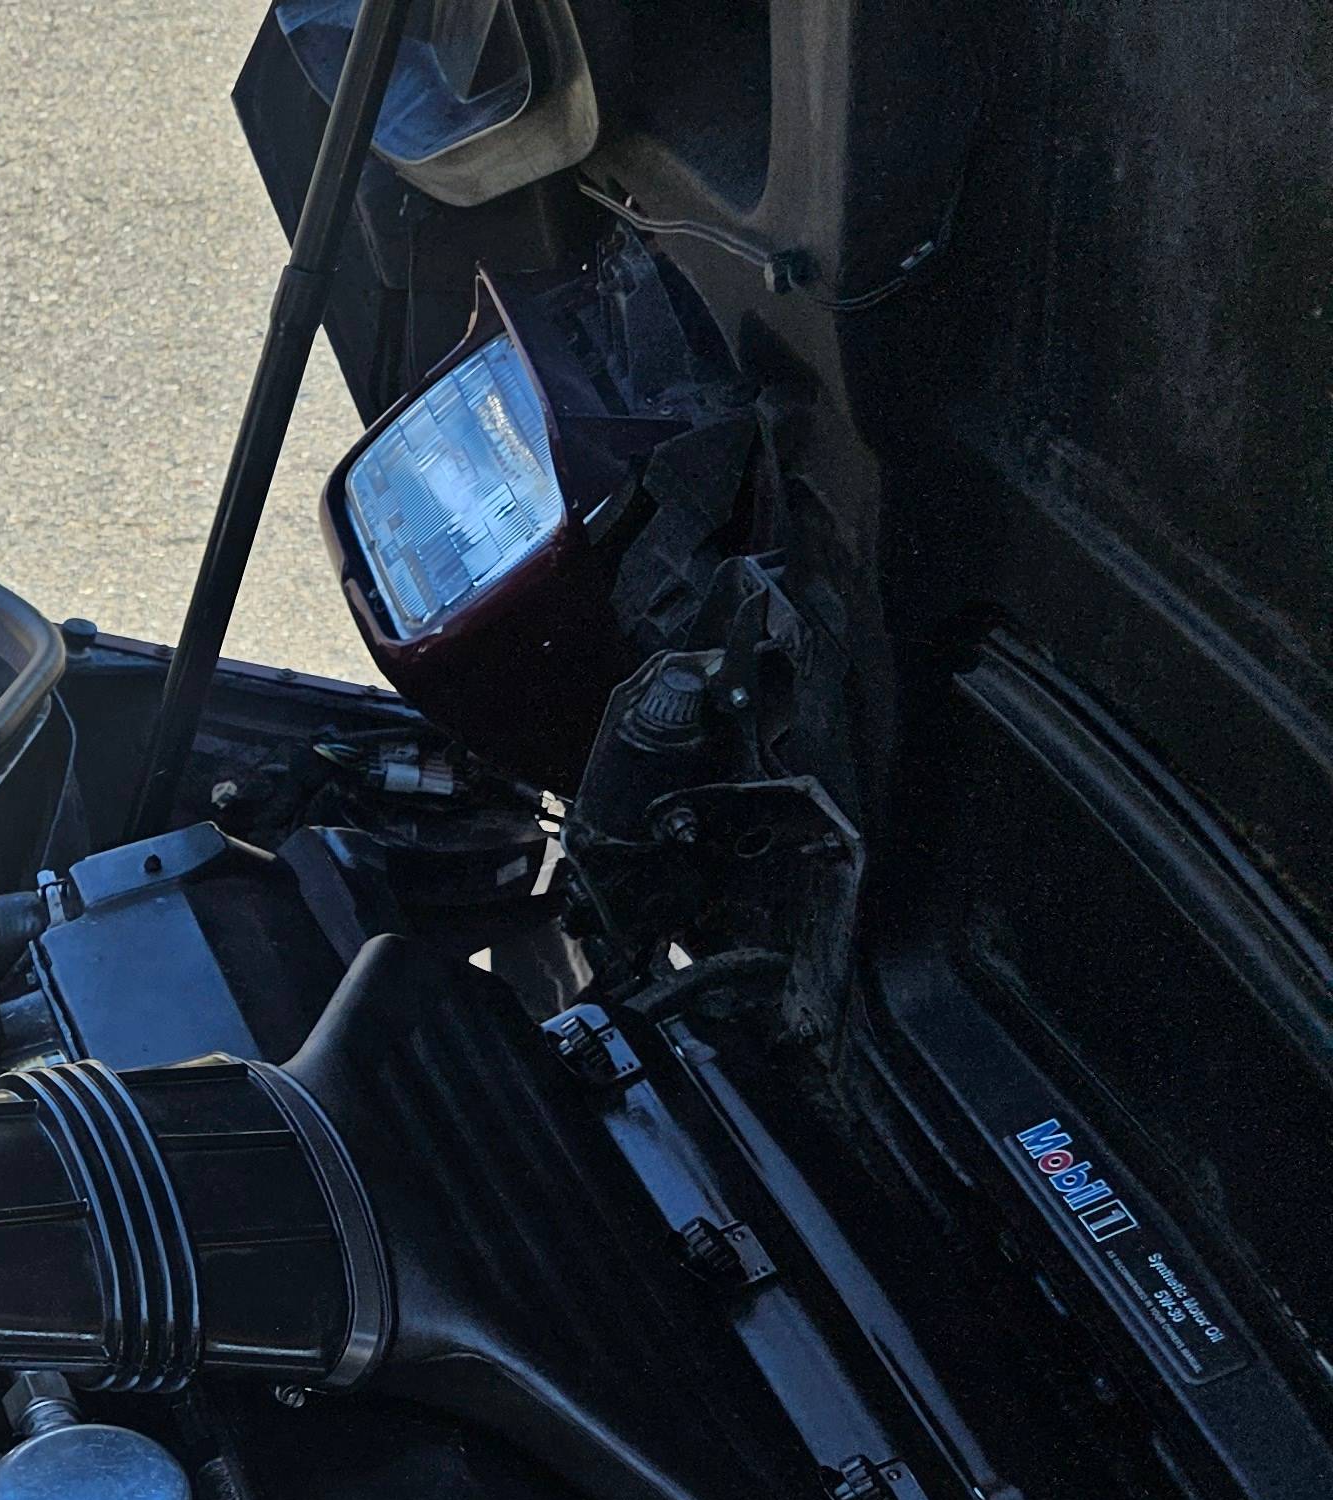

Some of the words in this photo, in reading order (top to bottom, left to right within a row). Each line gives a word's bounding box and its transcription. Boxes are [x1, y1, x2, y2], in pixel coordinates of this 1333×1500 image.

[1016, 1118, 1113, 1211] Mobil
[1148, 1253, 1187, 1300] Synthetic
[1182, 1295, 1211, 1328] Motor
[1204, 1326, 1225, 1343] Oil
[1153, 1290, 1185, 1323] 5W-30
